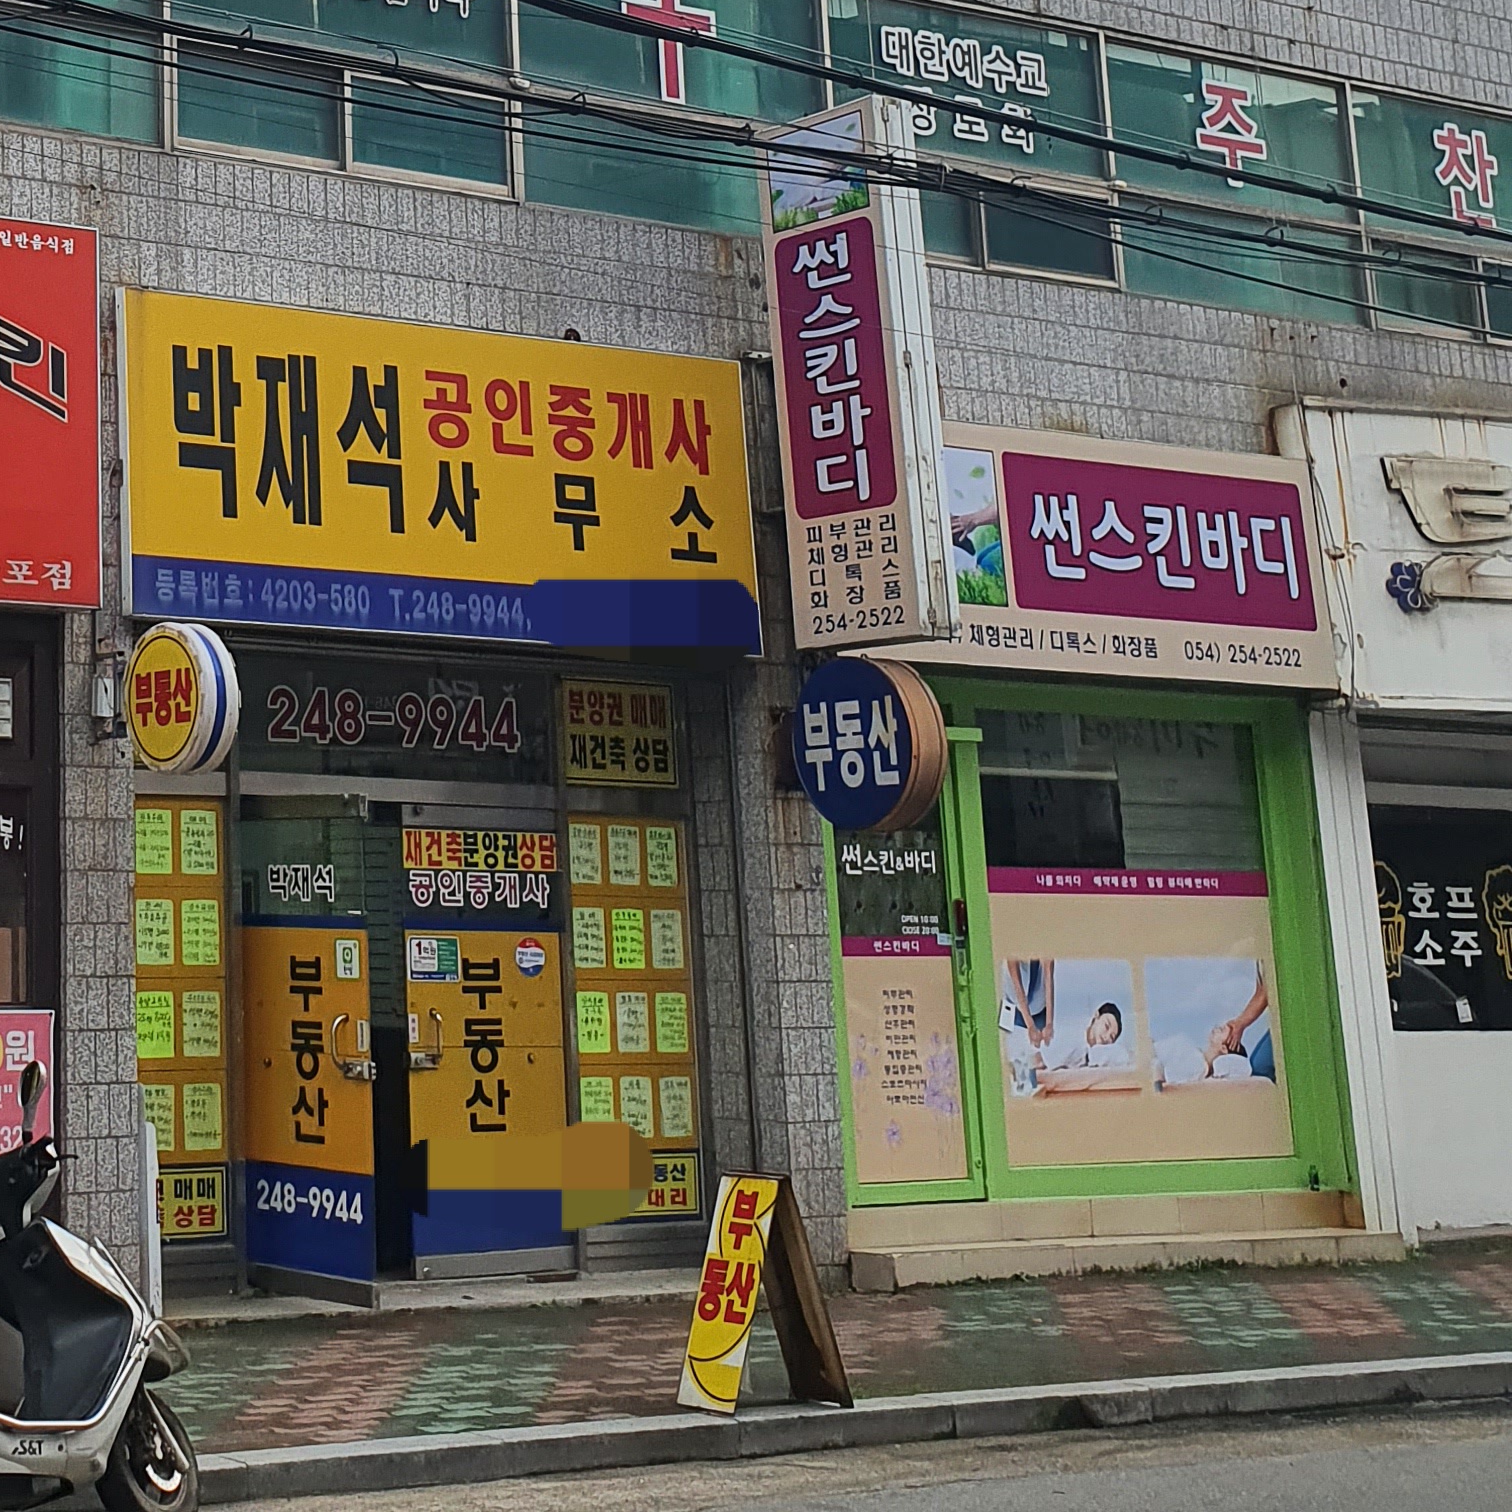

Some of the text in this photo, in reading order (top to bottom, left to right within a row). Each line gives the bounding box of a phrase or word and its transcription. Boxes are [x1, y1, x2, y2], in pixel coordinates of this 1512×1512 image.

[880, 24, 1050, 97] 대한예수교
[791, 230, 873, 504] 썬스킨바디
[170, 342, 713, 536] 박재석 공인중개사
[427, 459, 719, 565] 사무소
[806, 512, 897, 545] 피부관리
[808, 534, 899, 567] 체형관리
[1029, 491, 1301, 602] 썬스킨바디
[809, 557, 901, 588] 디톡스
[260, 577, 372, 614] 4203-580
[810, 579, 902, 609] 화장품
[812, 604, 906, 635] 254-2522
[968, 621, 1303, 669] 체형관리 디톡스 화장품 054) 254-2522
[133, 667, 193, 729] 부동산
[265, 683, 522, 754] 248-9944
[568, 688, 667, 729] 분양권 매매
[569, 733, 669, 774] 재건축 상담
[802, 694, 900, 792] 부동산
[404, 829, 557, 870] 재건축분양권상담
[841, 843, 937, 876] 썬스킨&바디
[266, 863, 550, 910] 박재석 공인중개사
[1407, 881, 1479, 919] 호프
[873, 940, 920, 953] 썬스킨바디
[1412, 929, 1483, 968] 소주
[288, 954, 330, 1147] 부동산
[459, 955, 511, 1134] 부동산
[172, 1174, 217, 1204] 매매
[653, 1162, 688, 1184] 동산
[173, 1202, 218, 1229] 상담
[255, 1178, 365, 1226] 248-9944
[695, 1188, 762, 1327] 부동산
[17, 1439, 45, 1456] S&T
